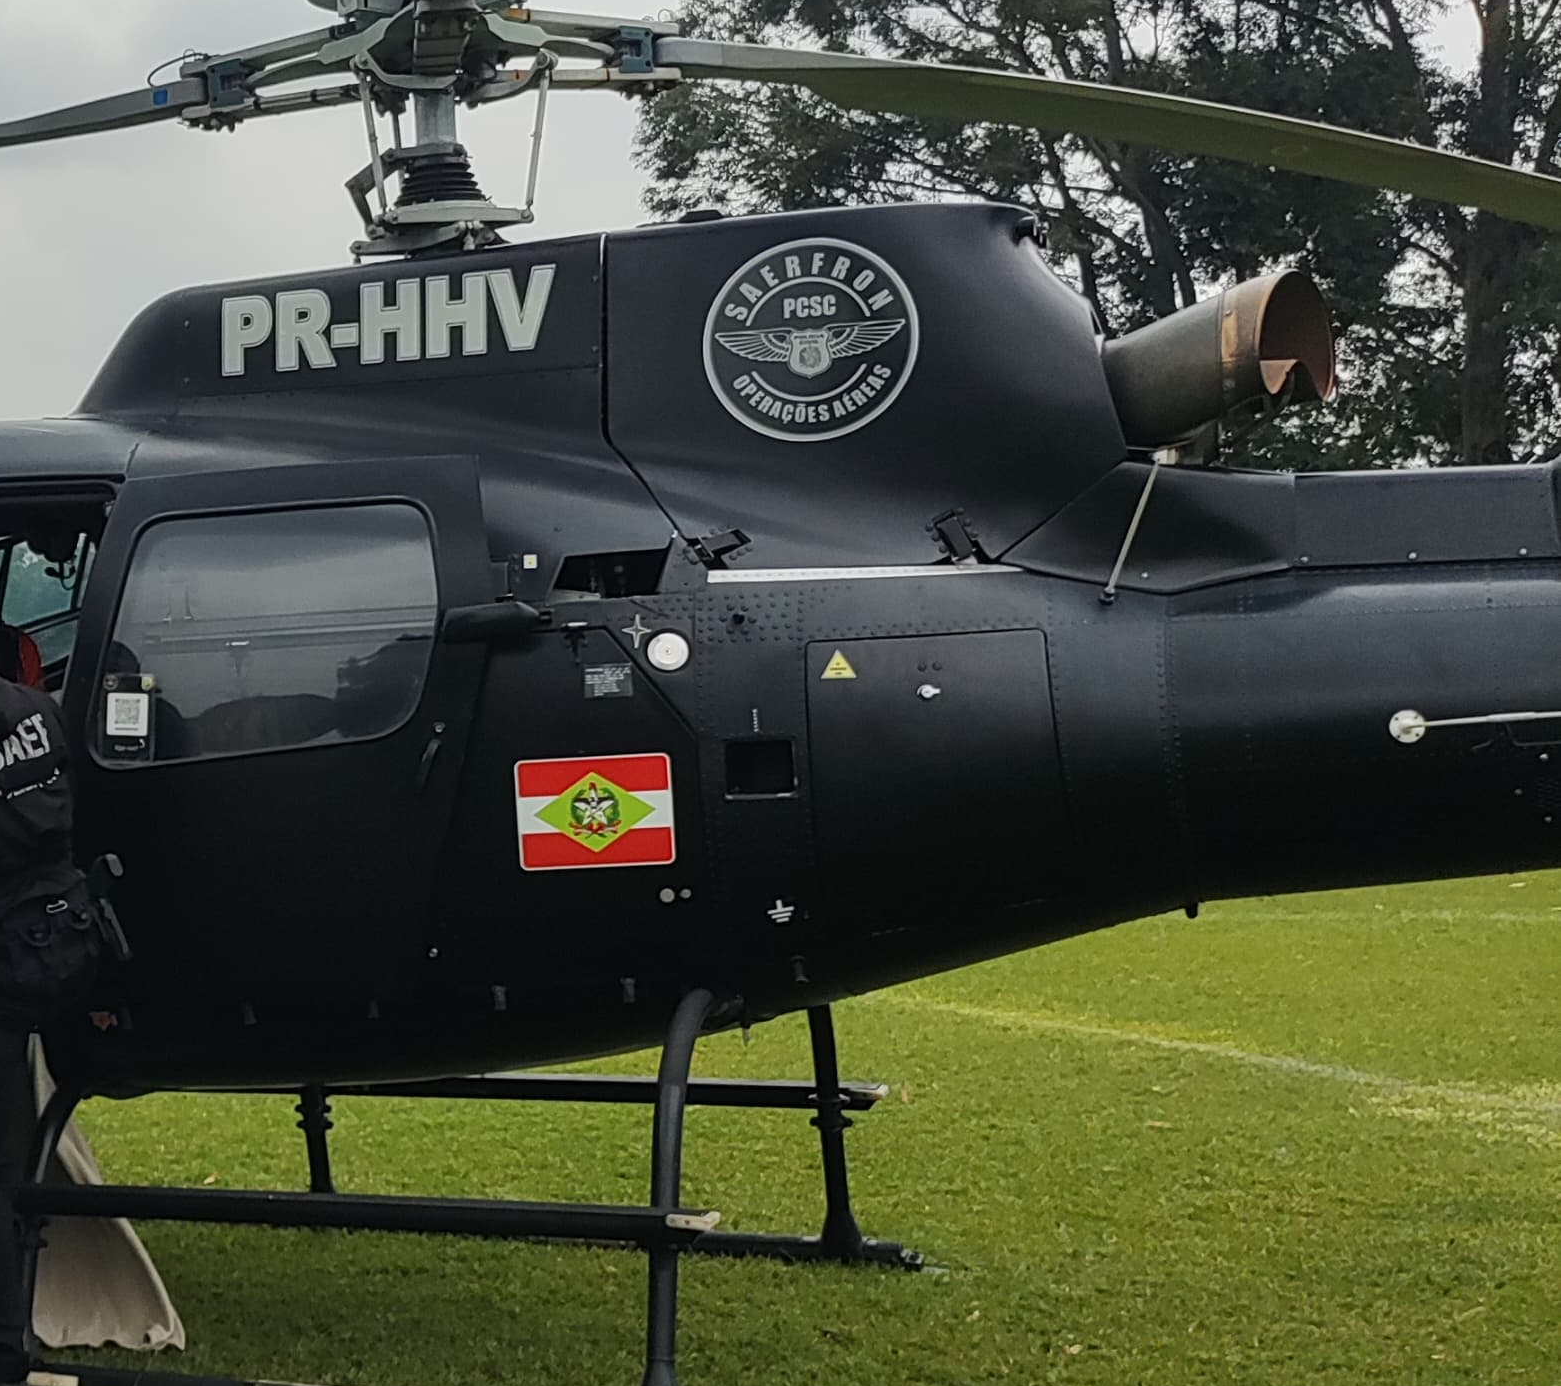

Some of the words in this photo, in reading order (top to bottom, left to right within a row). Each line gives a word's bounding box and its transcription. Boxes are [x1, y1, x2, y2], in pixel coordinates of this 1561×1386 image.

[725, 253, 894, 321] SAERFRON
[783, 295, 836, 319] PCSC
[221, 264, 556, 376] PR-HHV
[733, 374, 830, 424] OPERAÇÕES
[832, 364, 891, 418] AÉREAS
